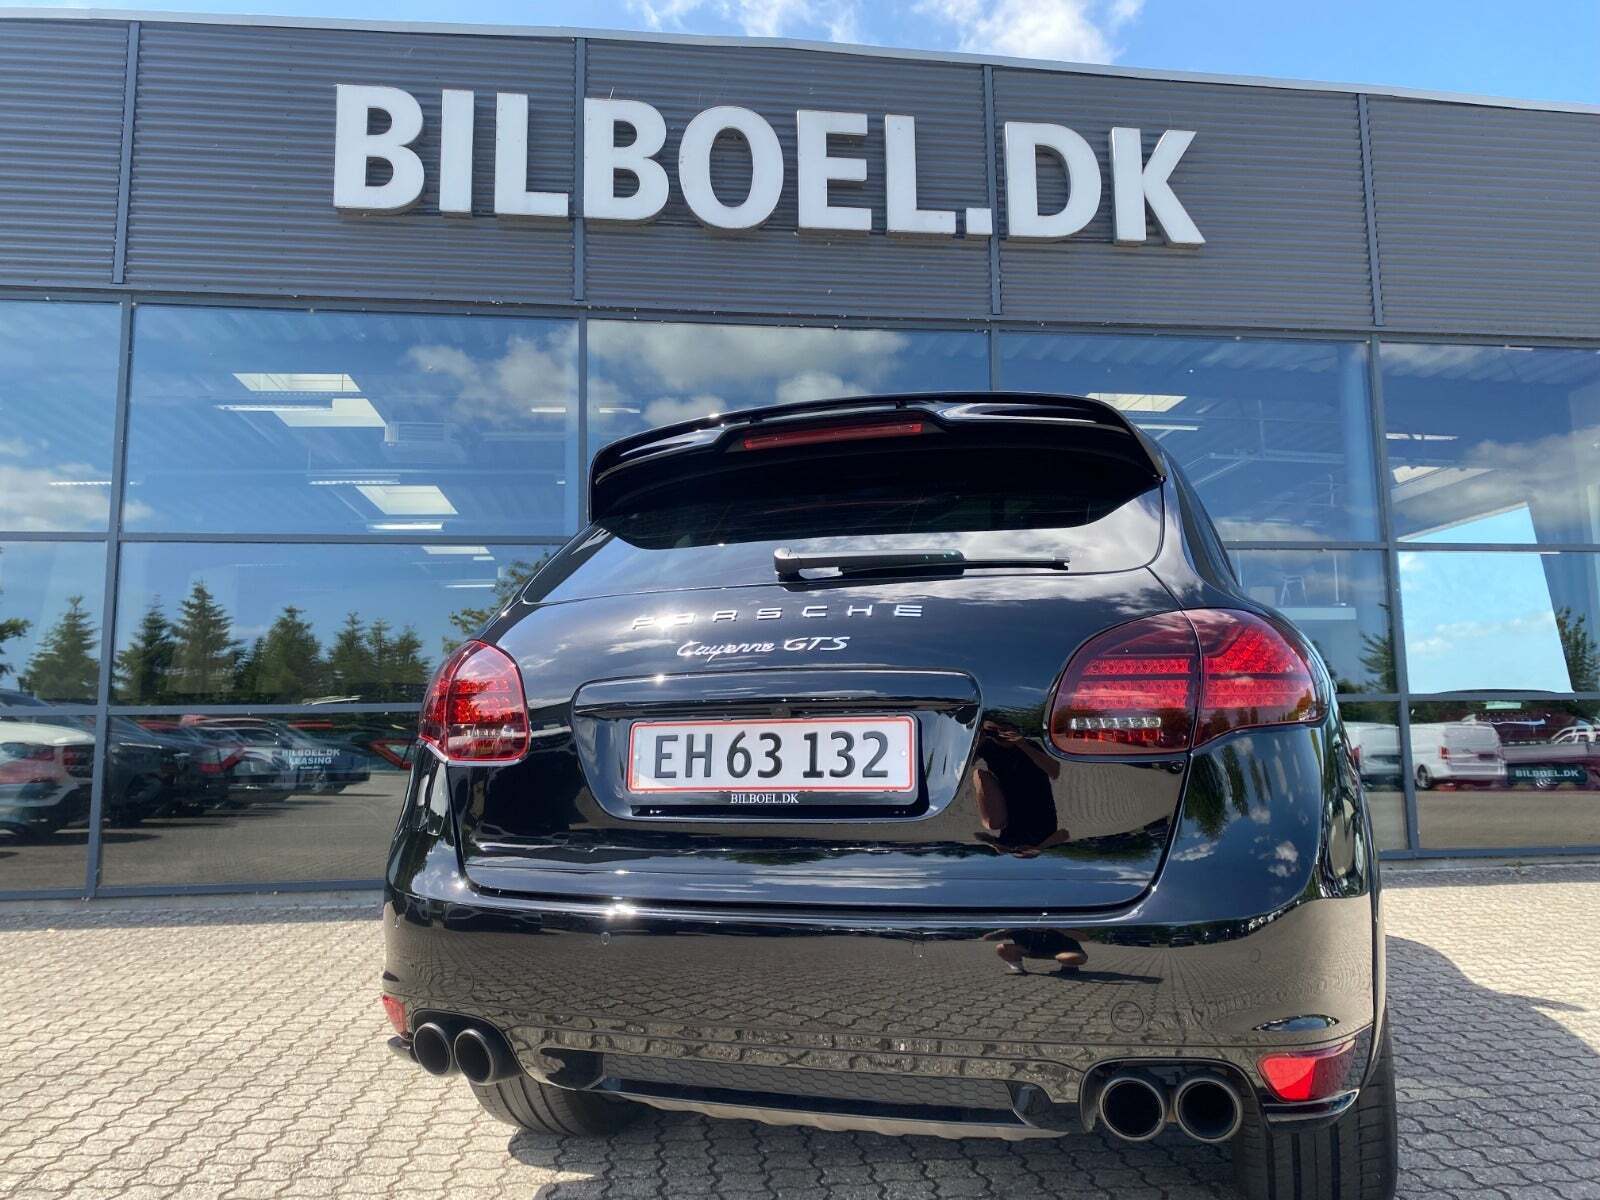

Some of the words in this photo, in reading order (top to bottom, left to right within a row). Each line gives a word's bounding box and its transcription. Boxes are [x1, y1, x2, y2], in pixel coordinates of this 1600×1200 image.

[332, 83, 1207, 248] BILBOEL.DK
[631, 604, 924, 630] PORSCHE
[676, 640, 775, 663] Cayenne
[783, 636, 850, 651] GTS
[288, 757, 332, 765] LEASING
[653, 733, 714, 780] EH
[726, 730, 783, 779] 63
[802, 730, 889, 779] 132
[729, 793, 800, 805] BILBOEL.DK
